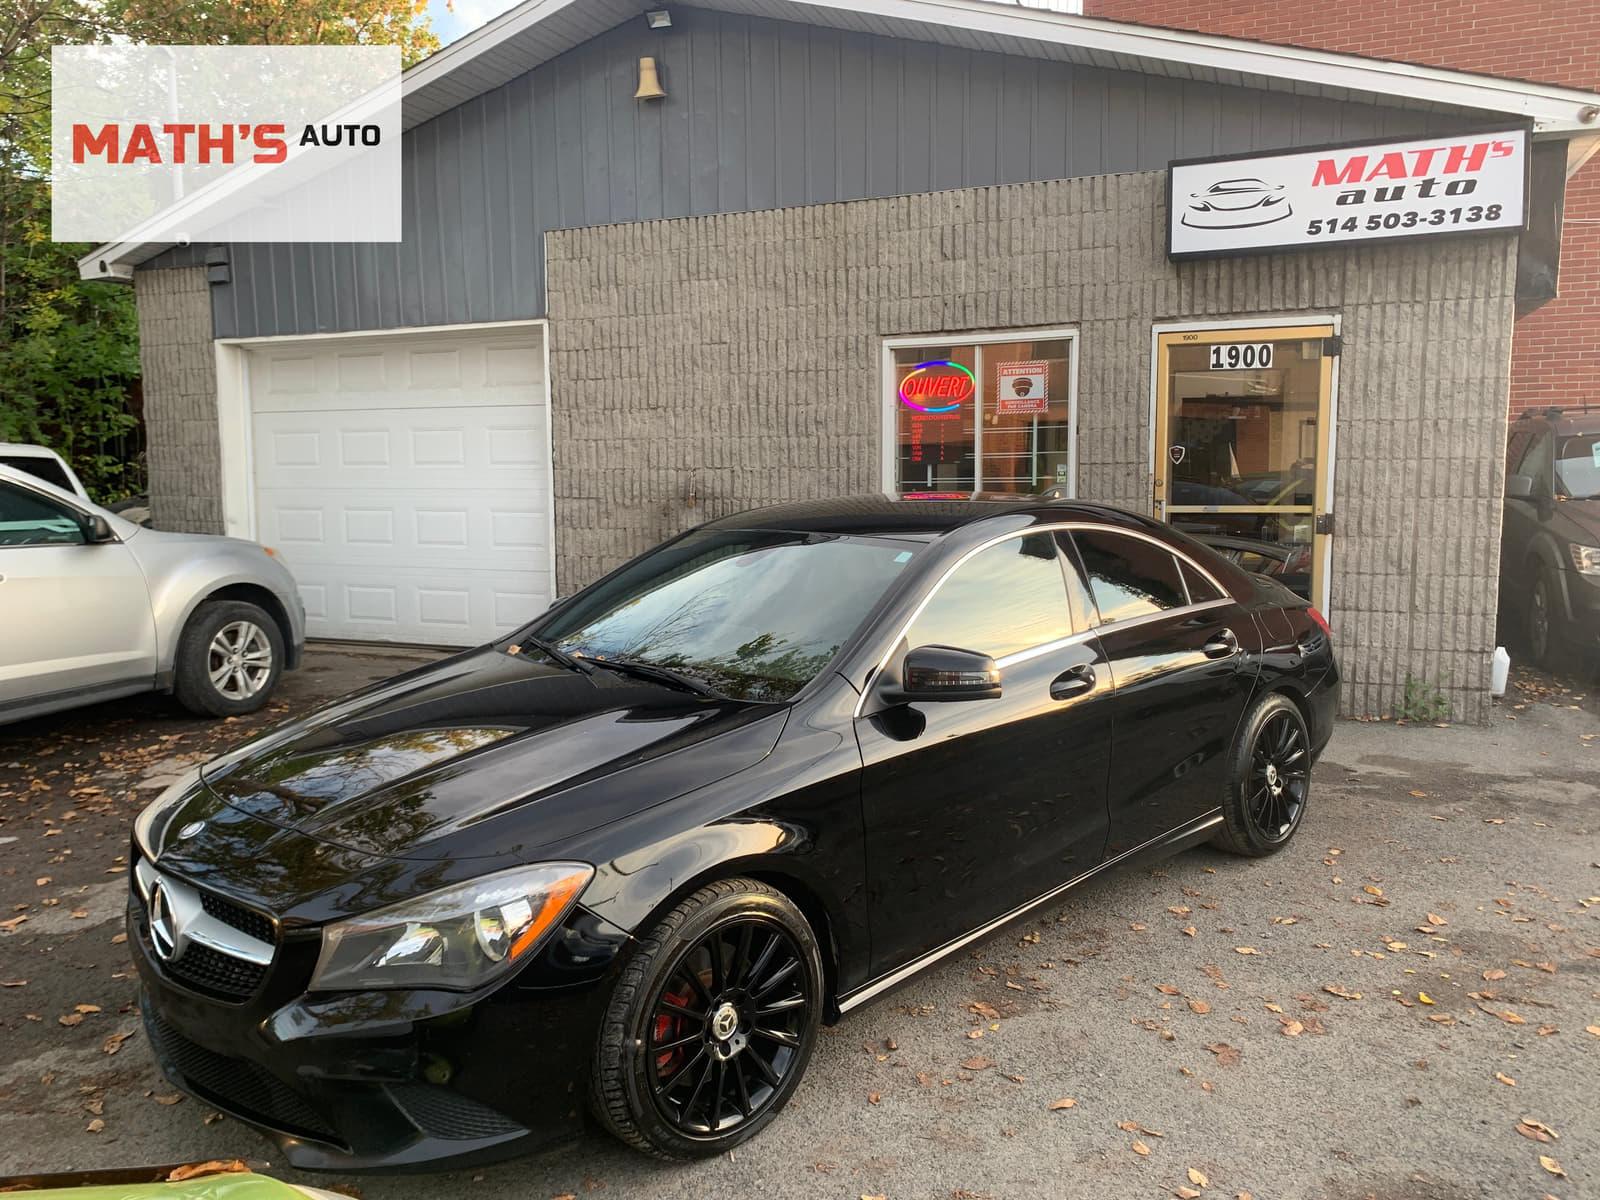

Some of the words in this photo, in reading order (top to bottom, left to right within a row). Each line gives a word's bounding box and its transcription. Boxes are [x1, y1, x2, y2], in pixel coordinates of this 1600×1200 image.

[1335, 177, 1479, 206] auto
[1306, 215, 1359, 236] 514
[1365, 203, 1503, 231] 503-3138
[1210, 344, 1272, 369] 1900
[1002, 367, 1043, 375] ATTENTION
[904, 375, 970, 398] OUVERT
